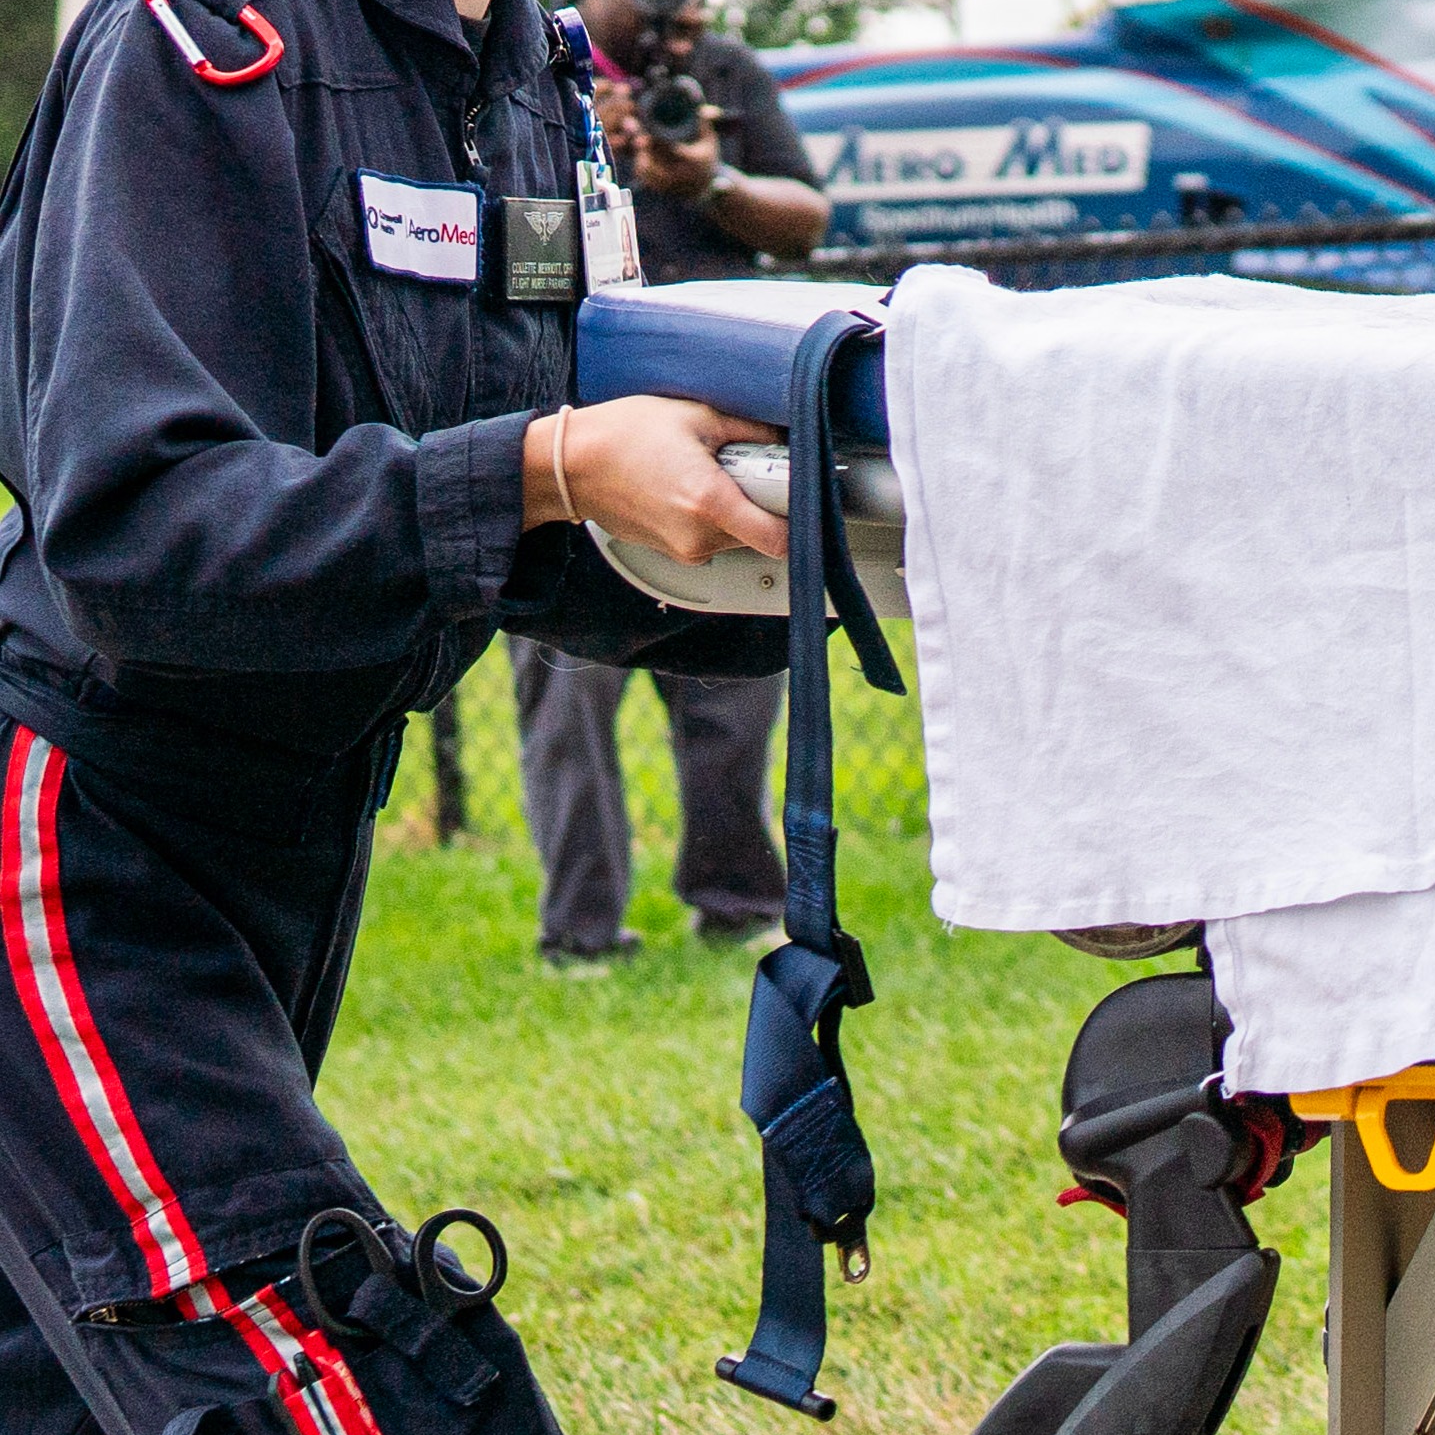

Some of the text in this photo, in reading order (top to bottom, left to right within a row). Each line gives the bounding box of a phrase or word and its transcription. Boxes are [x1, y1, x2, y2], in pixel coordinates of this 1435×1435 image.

[827, 116, 1130, 186] AERO MED
[409, 218, 476, 246] AeroMed
